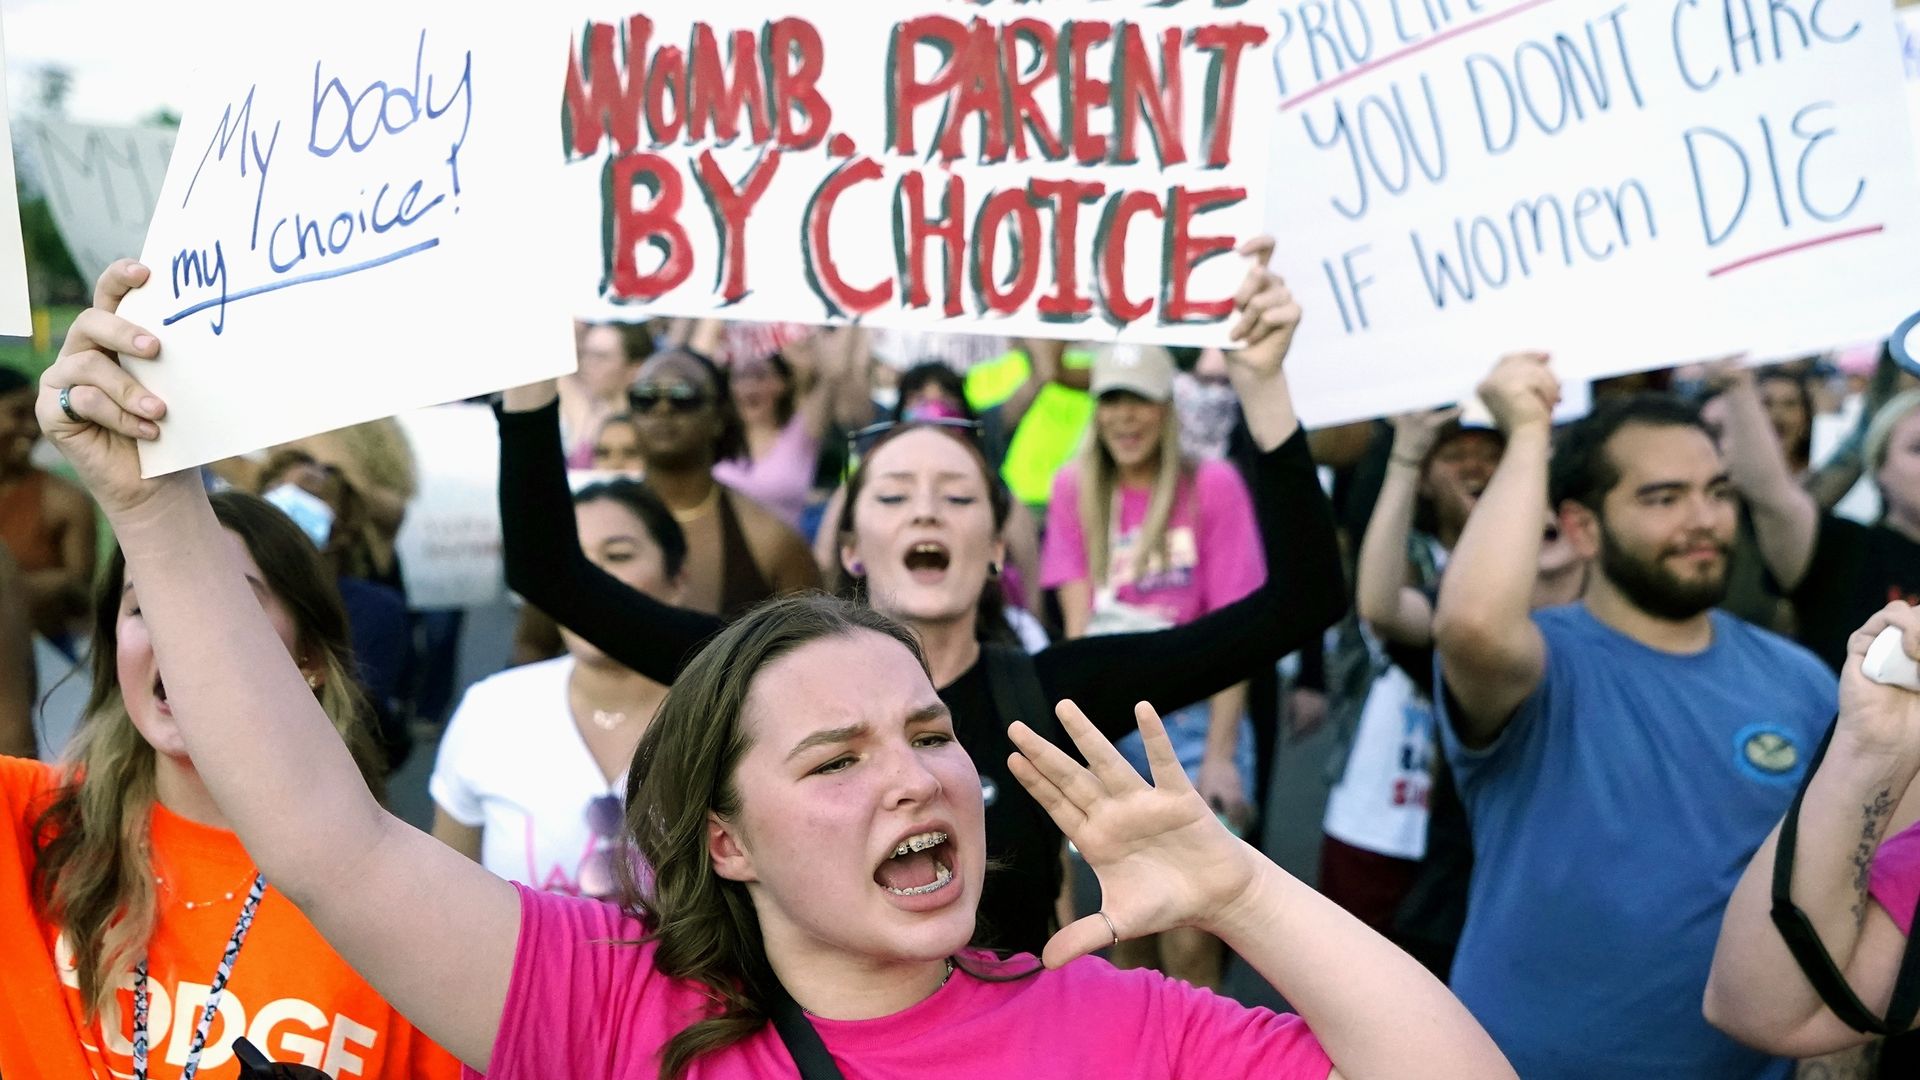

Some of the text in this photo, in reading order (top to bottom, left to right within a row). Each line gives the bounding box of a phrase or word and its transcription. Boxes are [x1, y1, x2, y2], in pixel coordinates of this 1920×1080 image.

[182, 28, 472, 251] My body
[884, 14, 1269, 172] PARENT
[1301, 73, 1447, 220] YOU
[1464, 4, 1646, 155] DONT
[171, 143, 463, 336] my choice!
[598, 147, 1248, 330] BY CHOICE
[1321, 244, 1376, 334] IF
[1682, 101, 1867, 248] DIE
